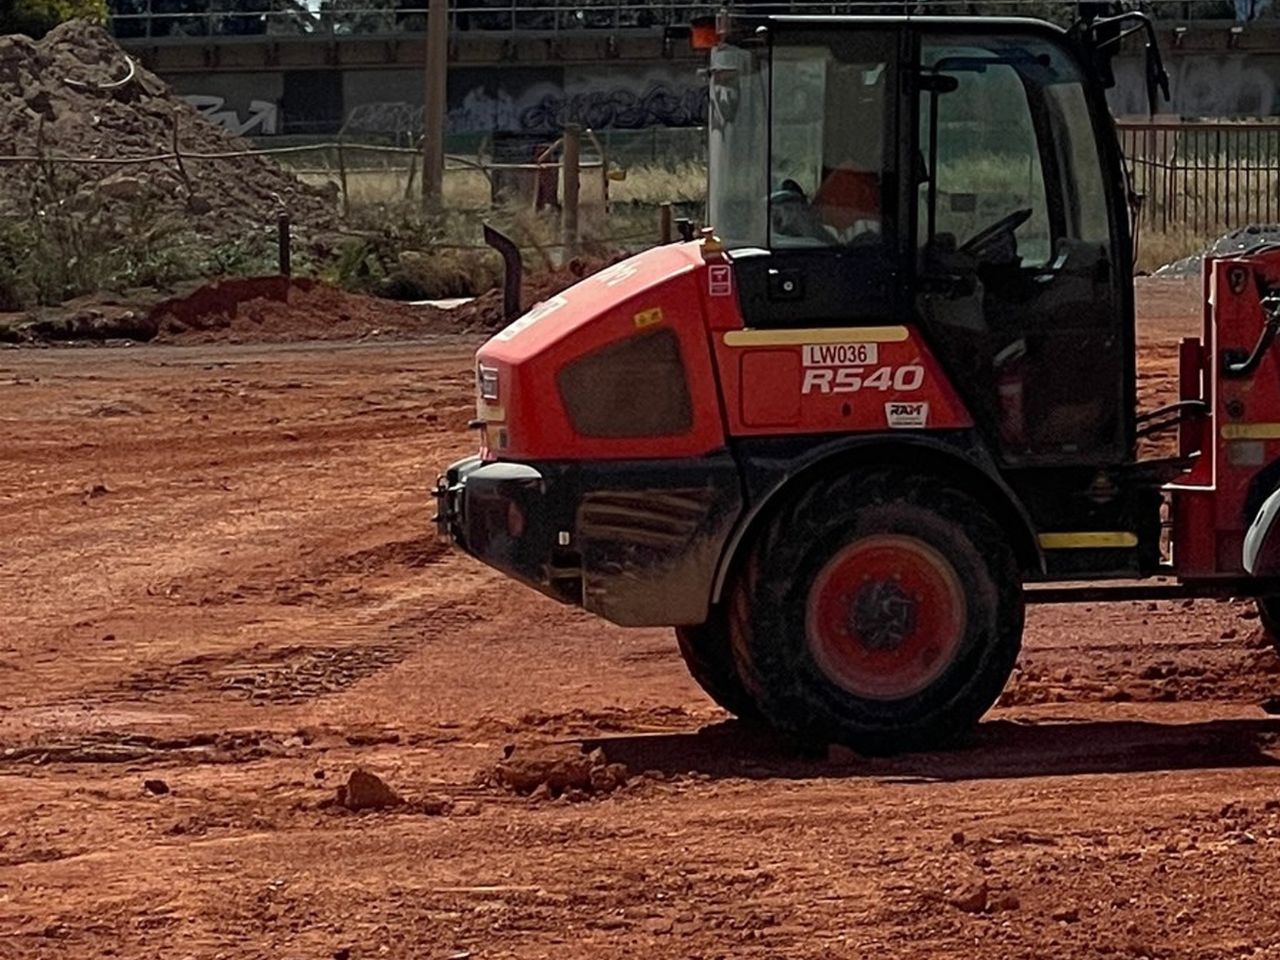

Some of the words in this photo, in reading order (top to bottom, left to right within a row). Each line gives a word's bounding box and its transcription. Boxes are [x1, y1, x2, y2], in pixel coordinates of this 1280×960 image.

[810, 345, 867, 364] LW036
[801, 365, 925, 394] R540
[890, 404, 924, 416] RAM
